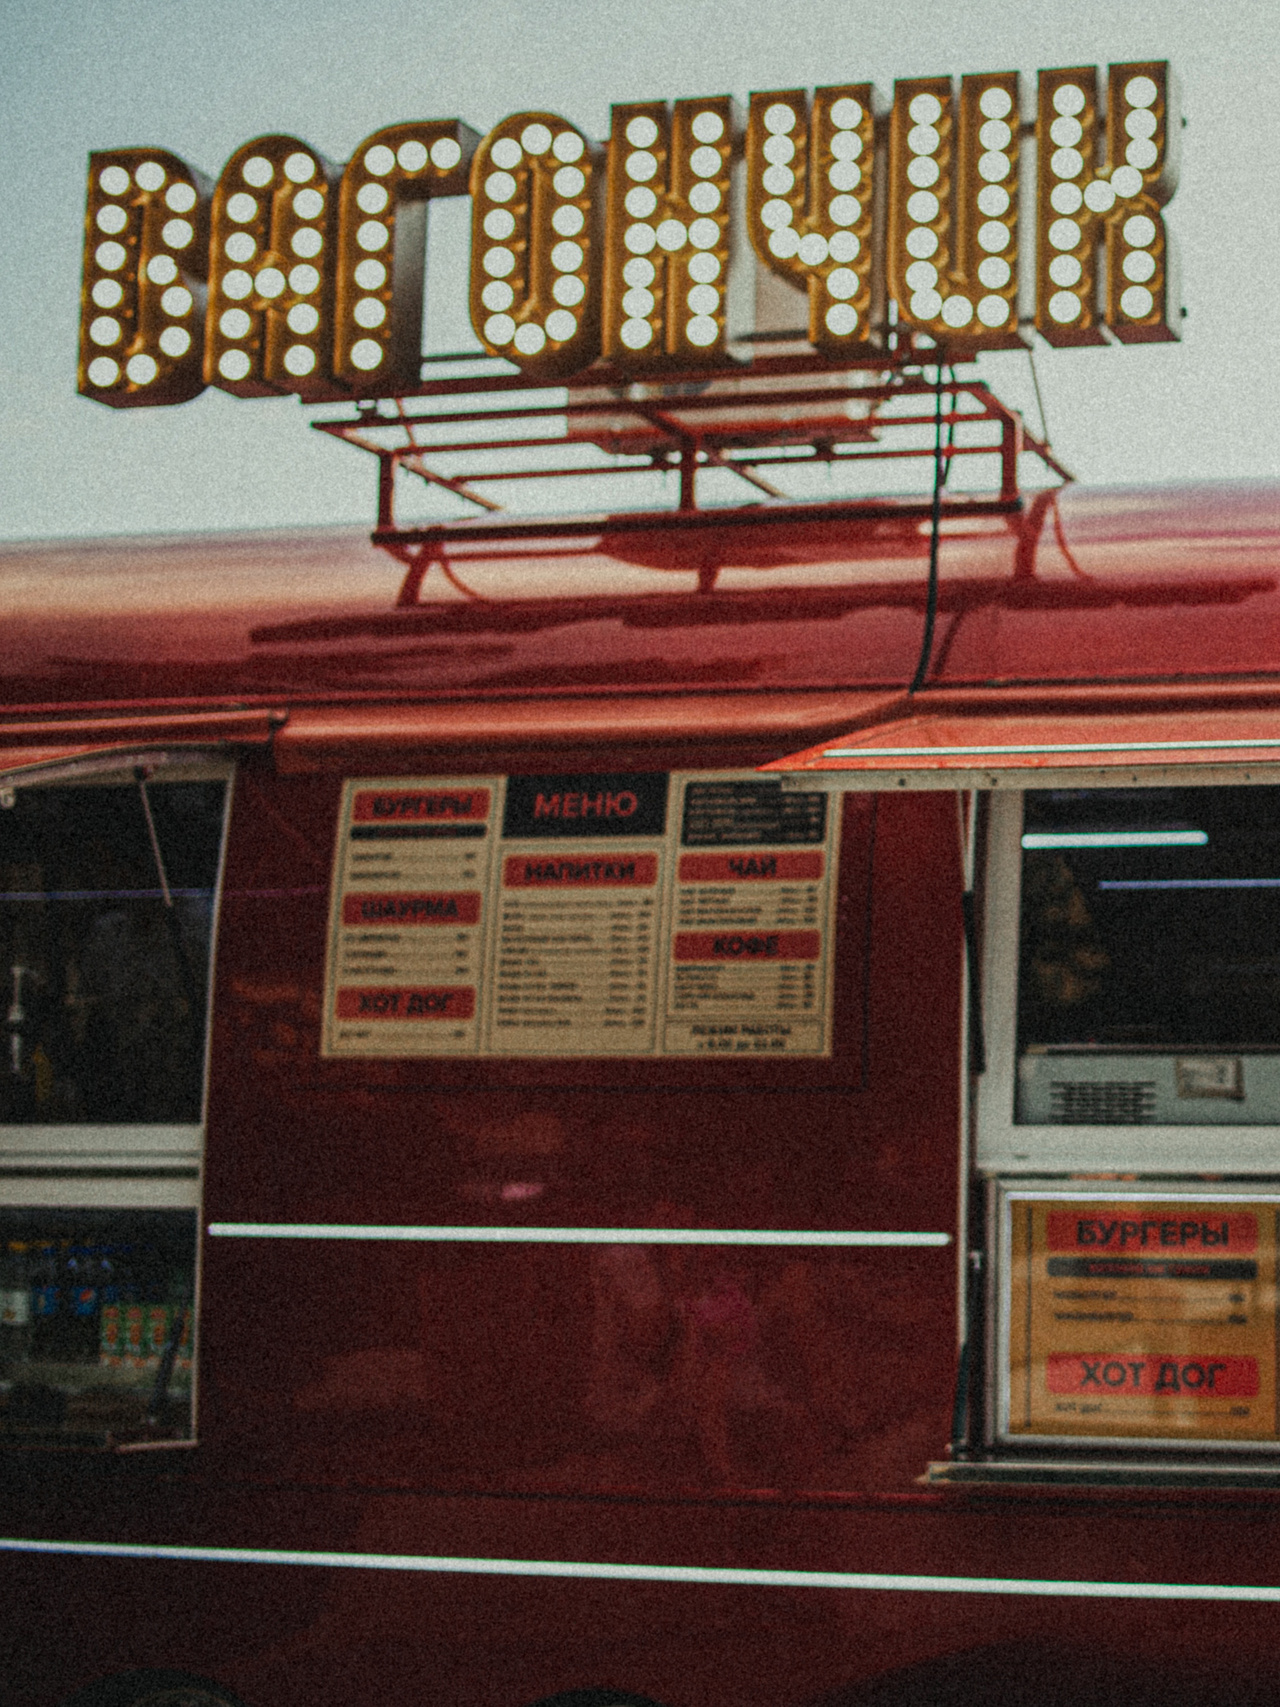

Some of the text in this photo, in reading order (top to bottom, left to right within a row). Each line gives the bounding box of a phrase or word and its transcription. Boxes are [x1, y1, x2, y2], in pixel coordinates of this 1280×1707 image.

[77, 60, 1172, 396] ВАГОНЧИК
[534, 790, 638, 819] МЕНЮ
[524, 861, 636, 882] НАПИТКИ
[729, 854, 778, 876] ЧАЙ
[361, 900, 459, 919] ШАУРМА
[713, 935, 780, 957] КОФЕ
[359, 993, 454, 1016] ХОТ ДОГ
[1076, 1219, 1230, 1249] БУРГЕРЫ
[1079, 1360, 1227, 1393] ХОТ ДОГ
